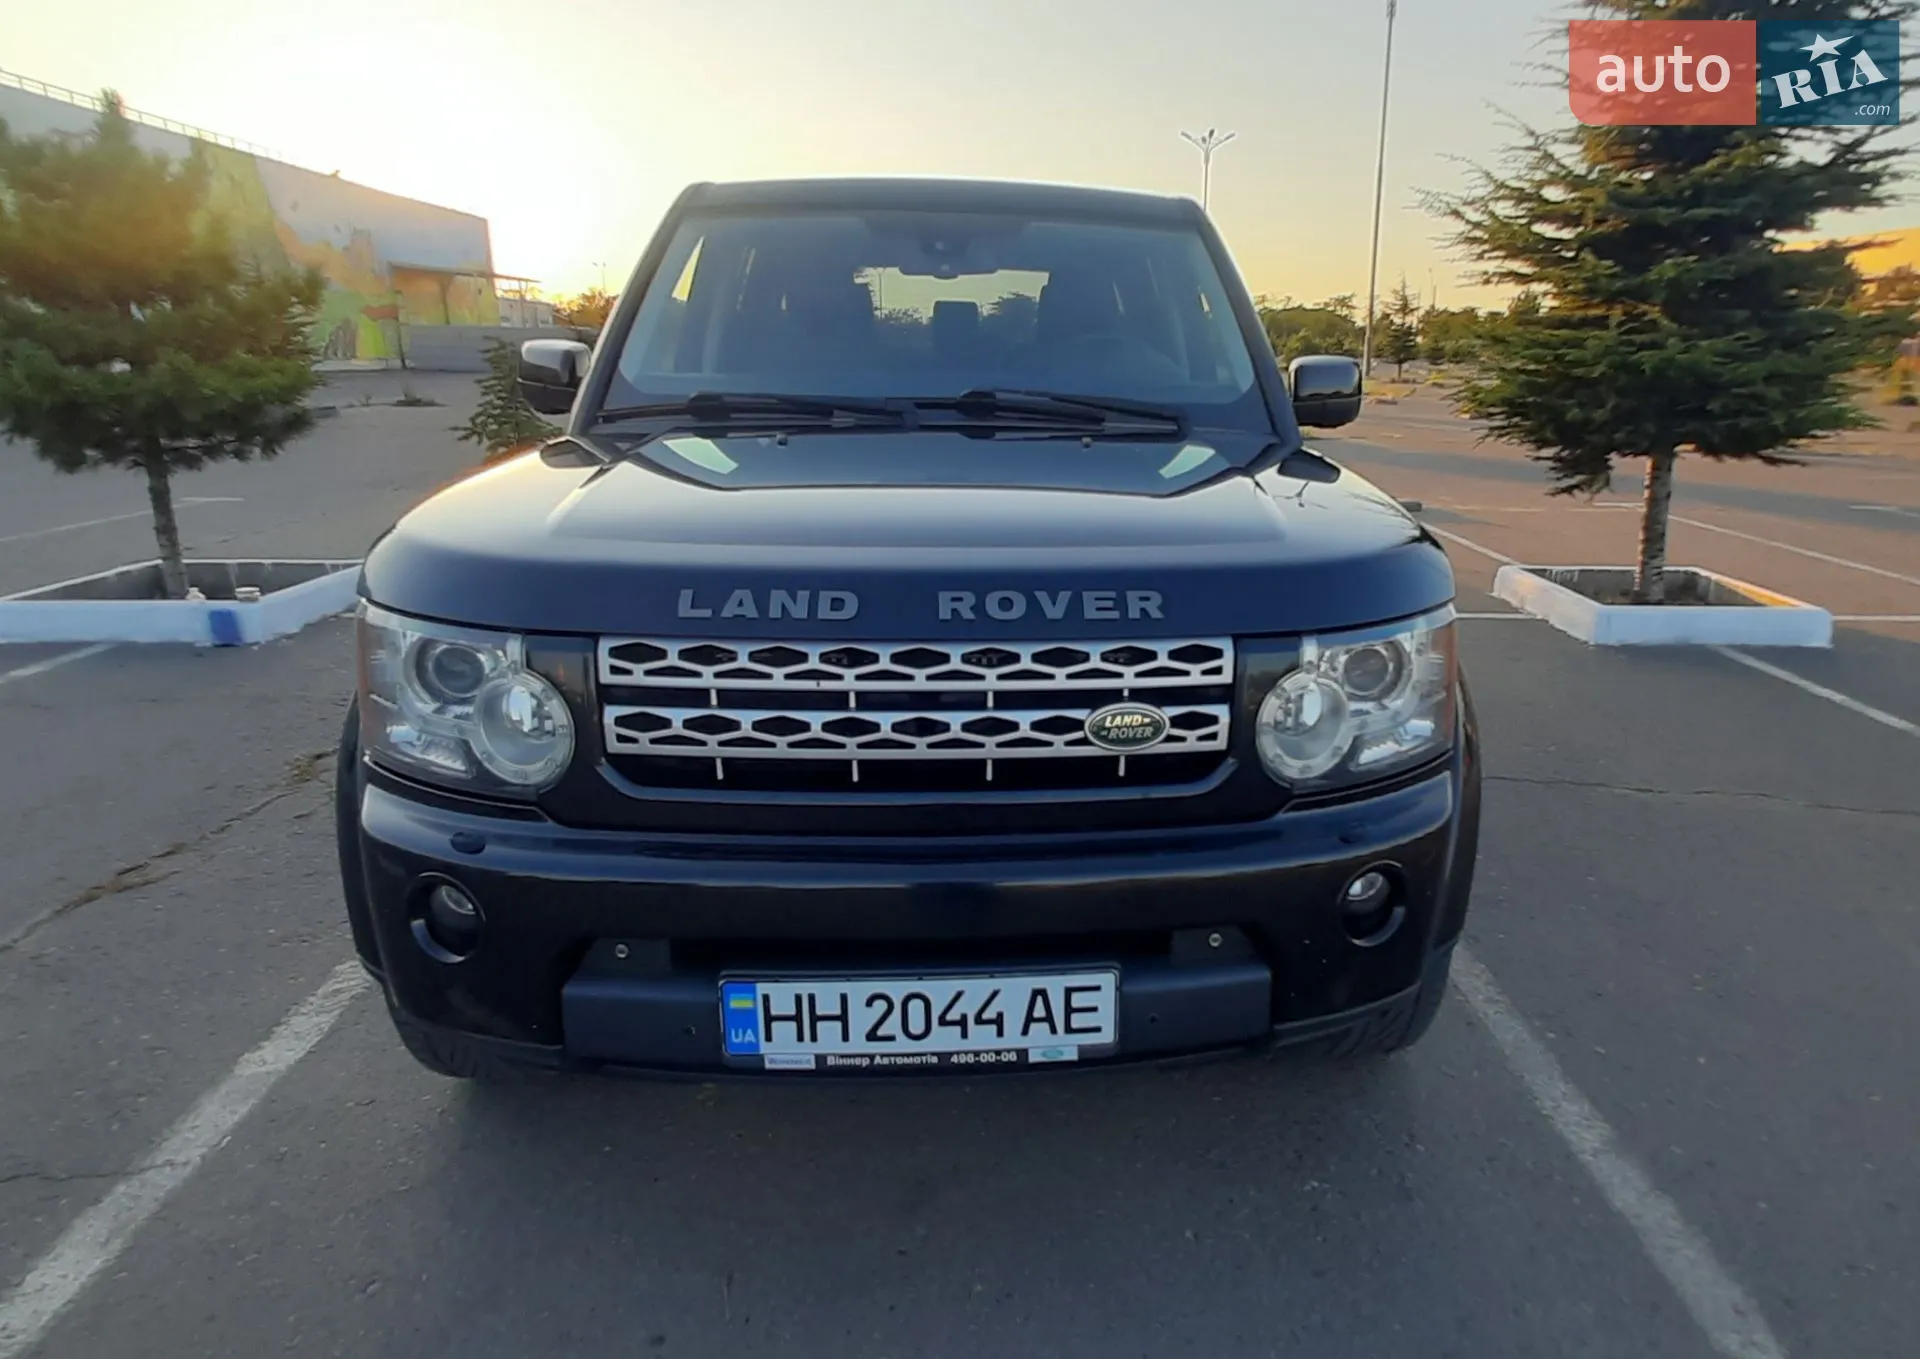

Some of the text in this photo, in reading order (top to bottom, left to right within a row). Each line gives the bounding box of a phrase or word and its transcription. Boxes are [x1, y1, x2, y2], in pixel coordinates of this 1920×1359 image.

[677, 588, 1165, 621] LAND ROVER
[864, 988, 1005, 1043] 2044
[1020, 984, 1103, 1037] AE
[730, 1027, 757, 1045] UA
